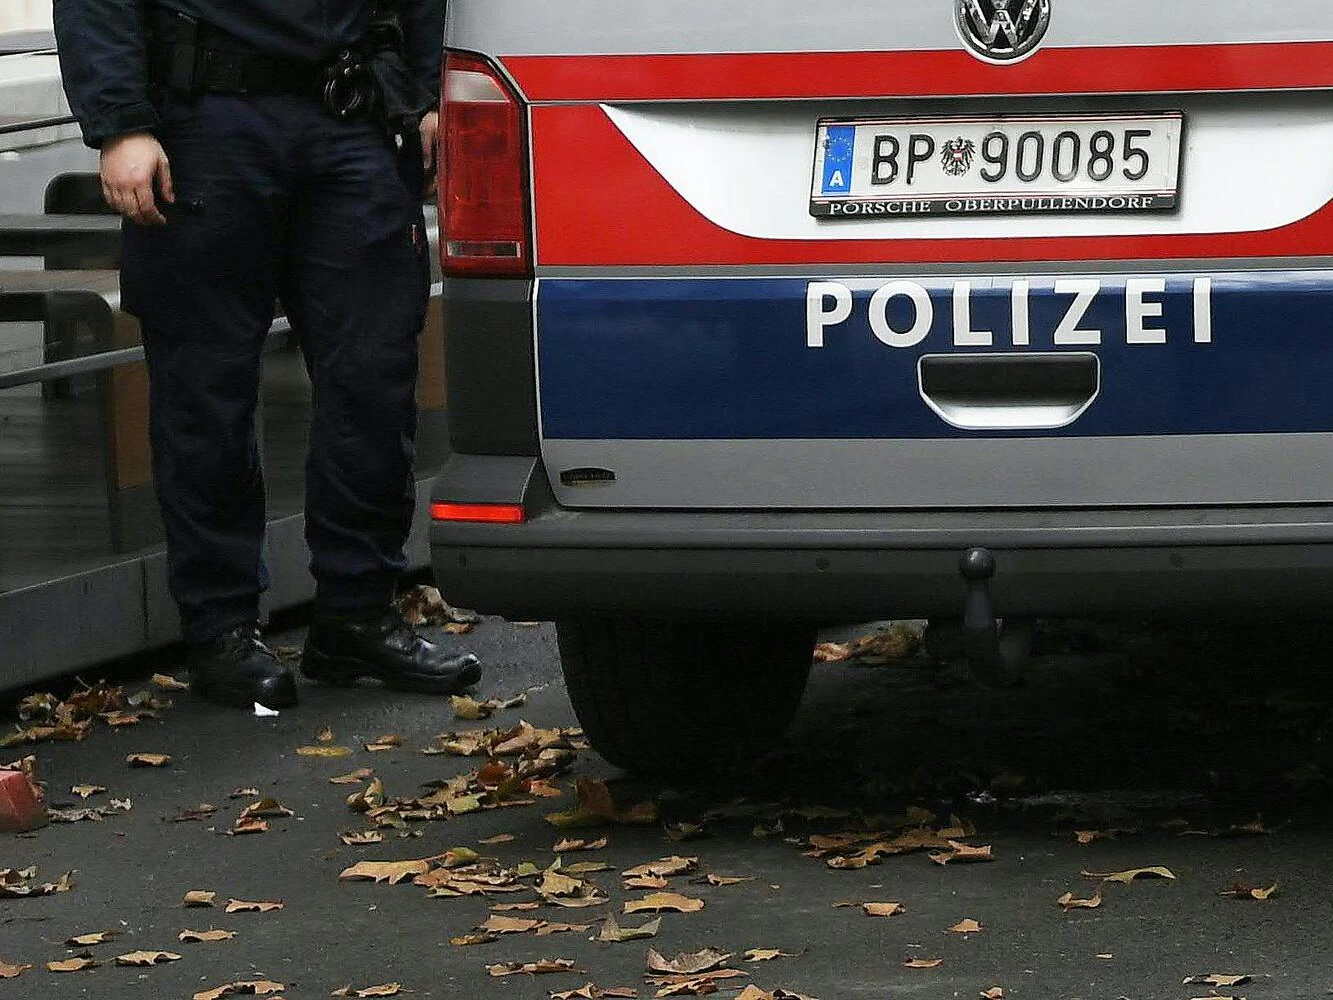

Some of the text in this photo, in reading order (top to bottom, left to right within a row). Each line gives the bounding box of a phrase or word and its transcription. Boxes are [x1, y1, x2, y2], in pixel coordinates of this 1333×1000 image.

[871, 129, 1152, 185] BP 90085
[829, 170, 845, 187] A
[829, 196, 1154, 215] PORSCHE OBERPULLENDORF
[806, 277, 1212, 348] POLIZEI
